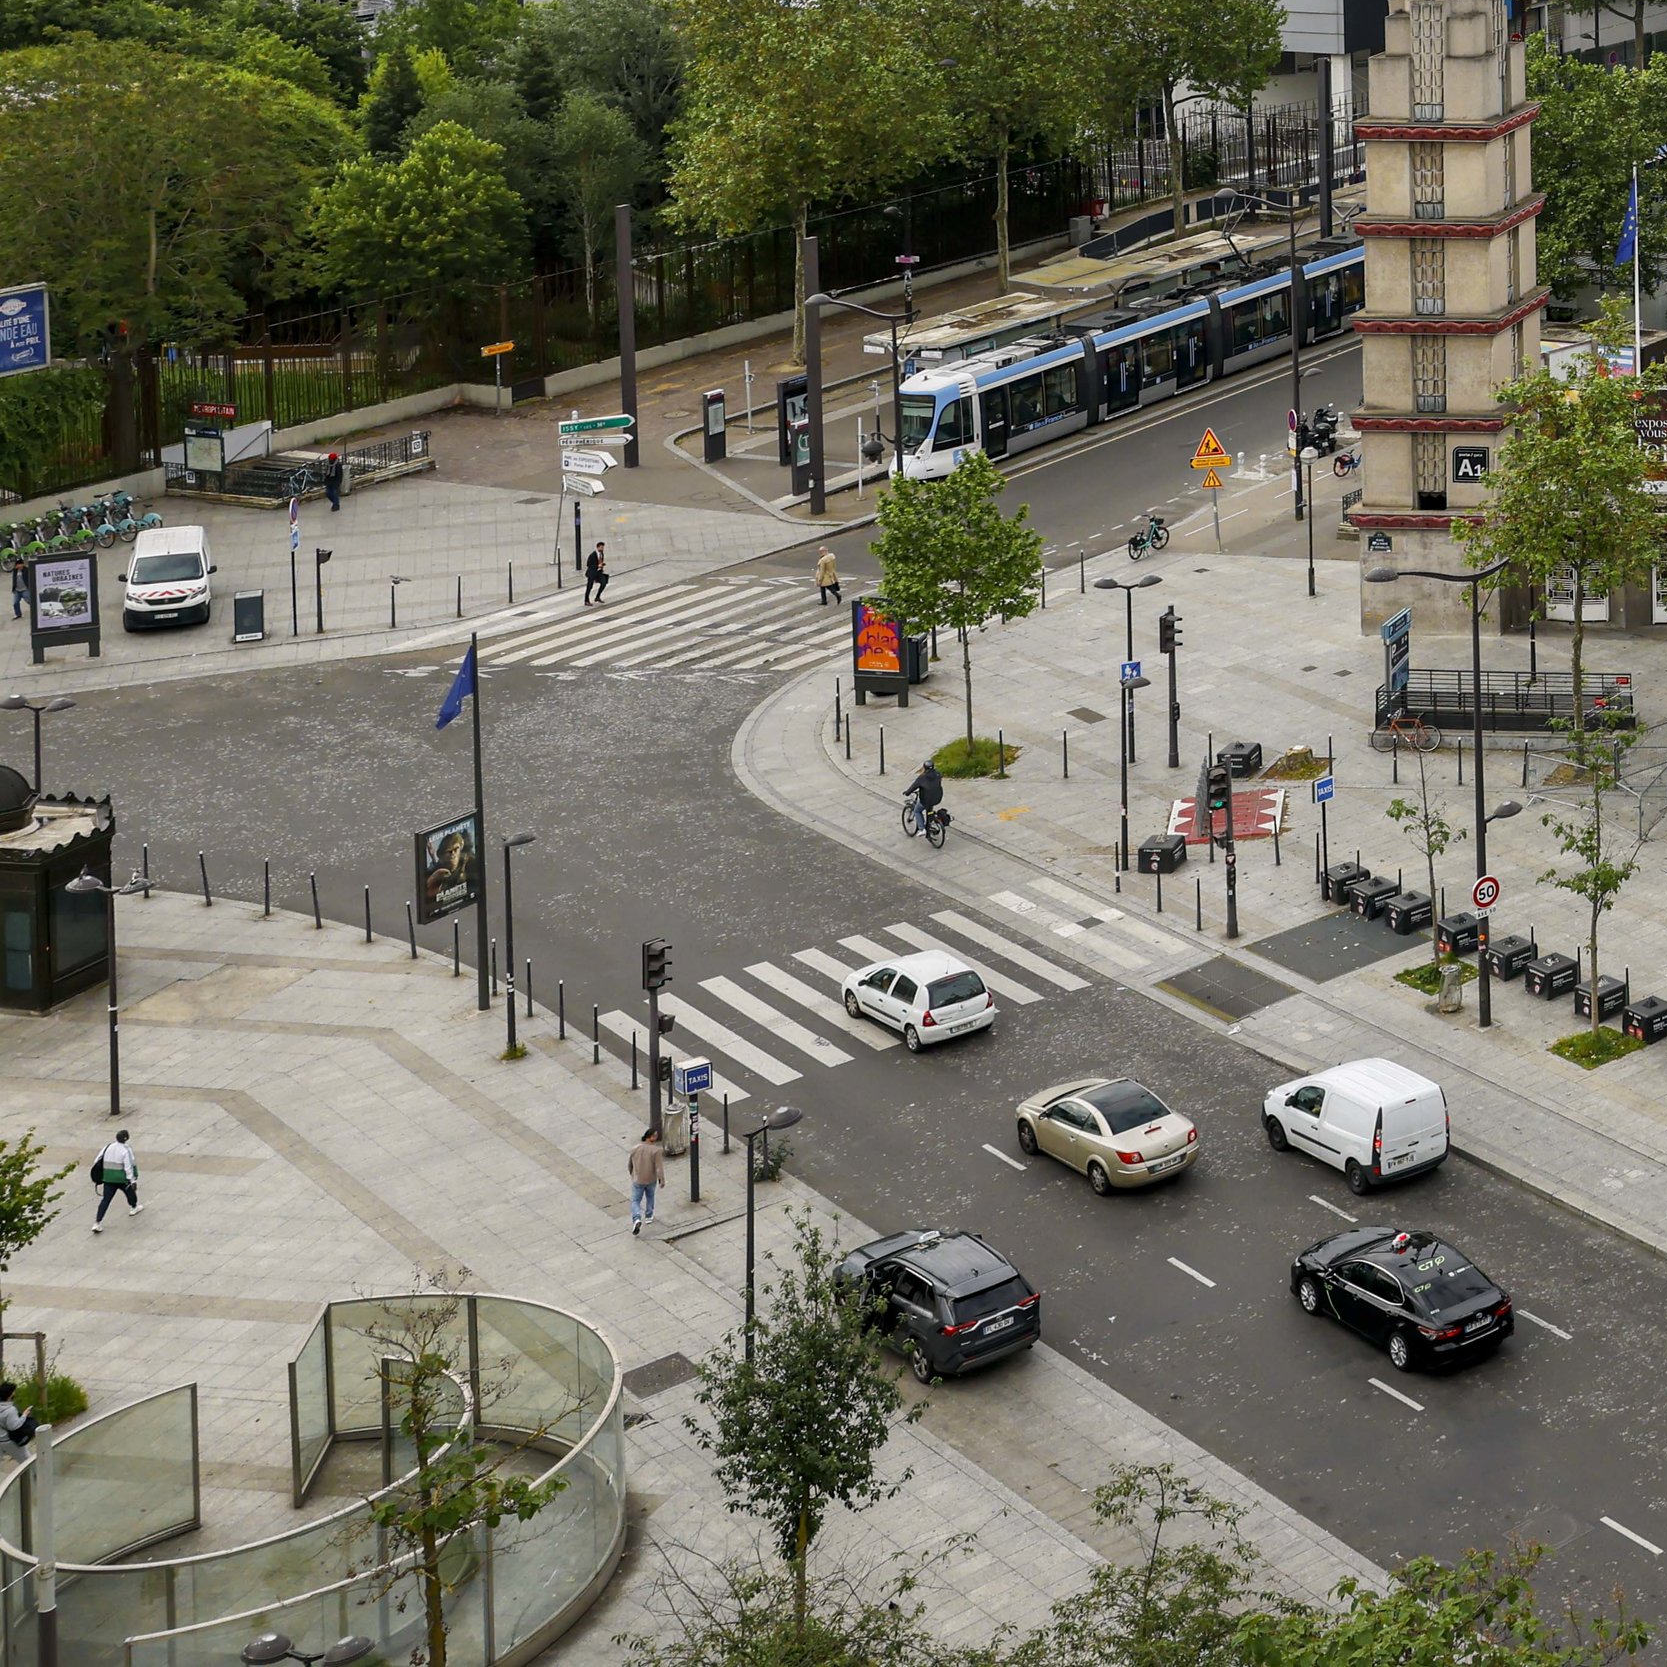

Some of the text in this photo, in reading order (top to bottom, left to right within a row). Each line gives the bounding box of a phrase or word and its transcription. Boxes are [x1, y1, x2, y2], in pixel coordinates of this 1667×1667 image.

[20, 323, 37, 337] EAU
[562, 424, 578, 432] ISSY
[1640, 429, 1667, 438] vous
[1458, 459, 1482, 478] A1
[42, 569, 70, 578] NATURES
[52, 573, 84, 582] URBAINES
[1318, 785, 1332, 796] TAXIS
[1479, 885, 1494, 901] 50
[688, 1073, 708, 1085] TAXIS
